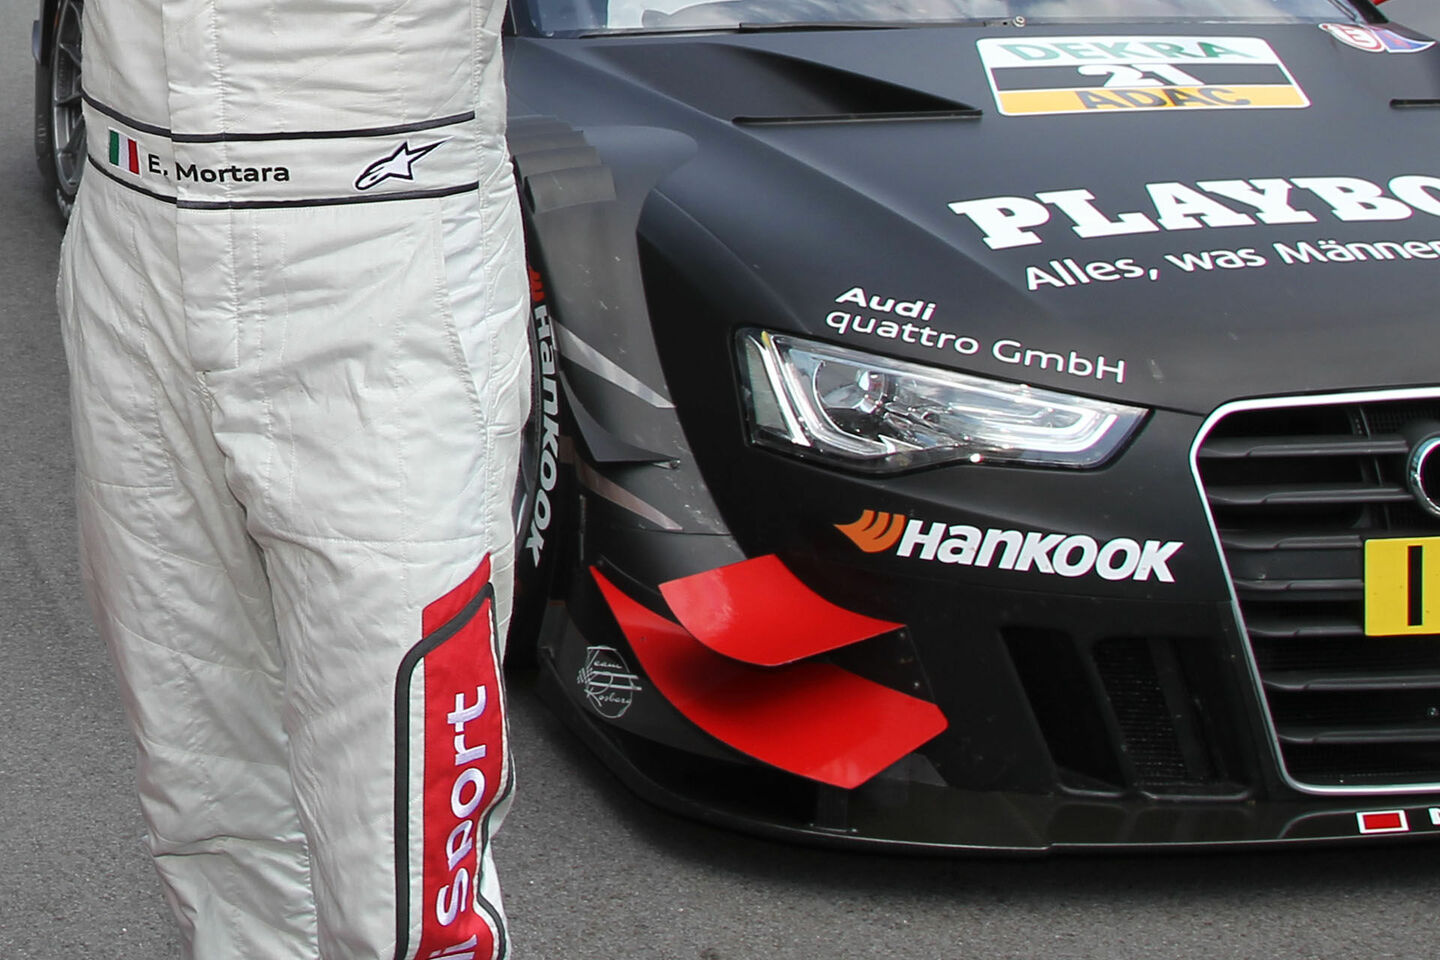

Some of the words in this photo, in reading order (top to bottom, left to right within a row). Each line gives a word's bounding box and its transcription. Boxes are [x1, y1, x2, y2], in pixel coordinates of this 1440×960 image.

[998, 41, 1258, 61] DEKRA
[1078, 64, 1206, 87] 21
[1075, 88, 1251, 110] ADAC
[148, 153, 168, 175] E.
[176, 162, 290, 182] Mortara
[1026, 258, 1159, 291] Alles,
[1164, 246, 1267, 273] was
[834, 287, 937, 321] Audi
[825, 310, 980, 355] quattro
[991, 339, 1127, 384] GmbH
[436, 685, 487, 926] Sport
